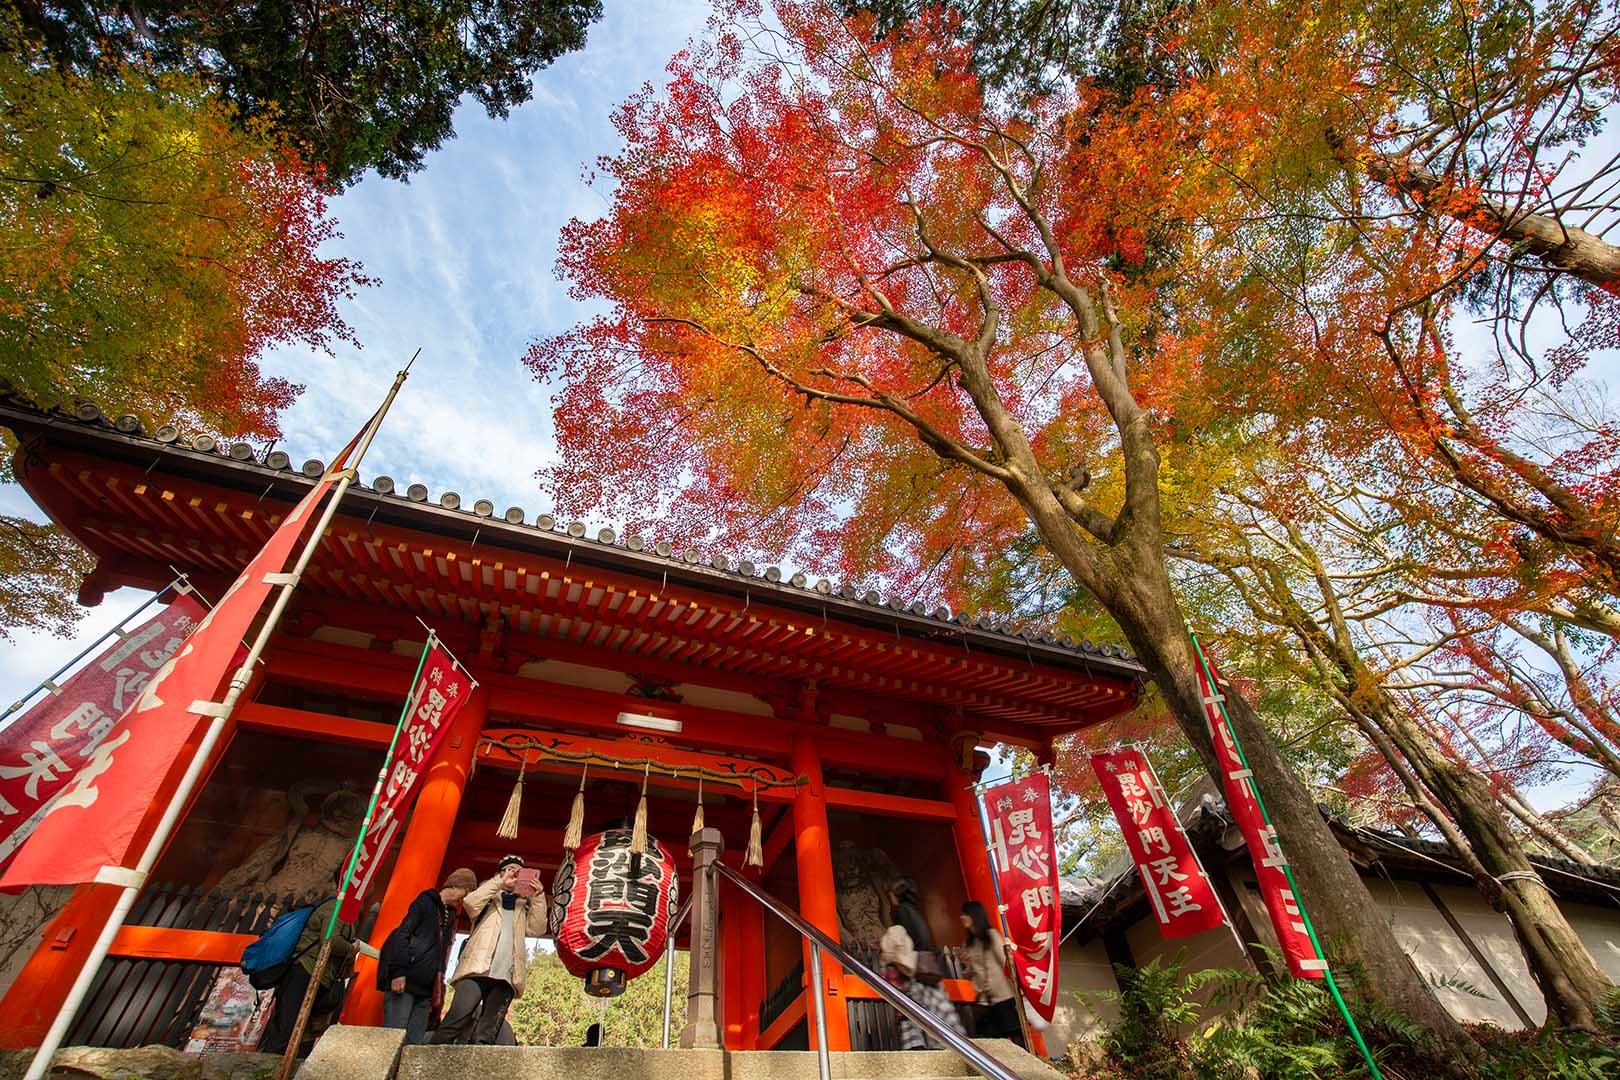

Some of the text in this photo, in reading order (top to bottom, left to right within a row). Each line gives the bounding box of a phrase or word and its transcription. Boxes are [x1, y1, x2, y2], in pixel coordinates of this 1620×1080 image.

[1116, 773, 1202, 917] 毘沙門天王
